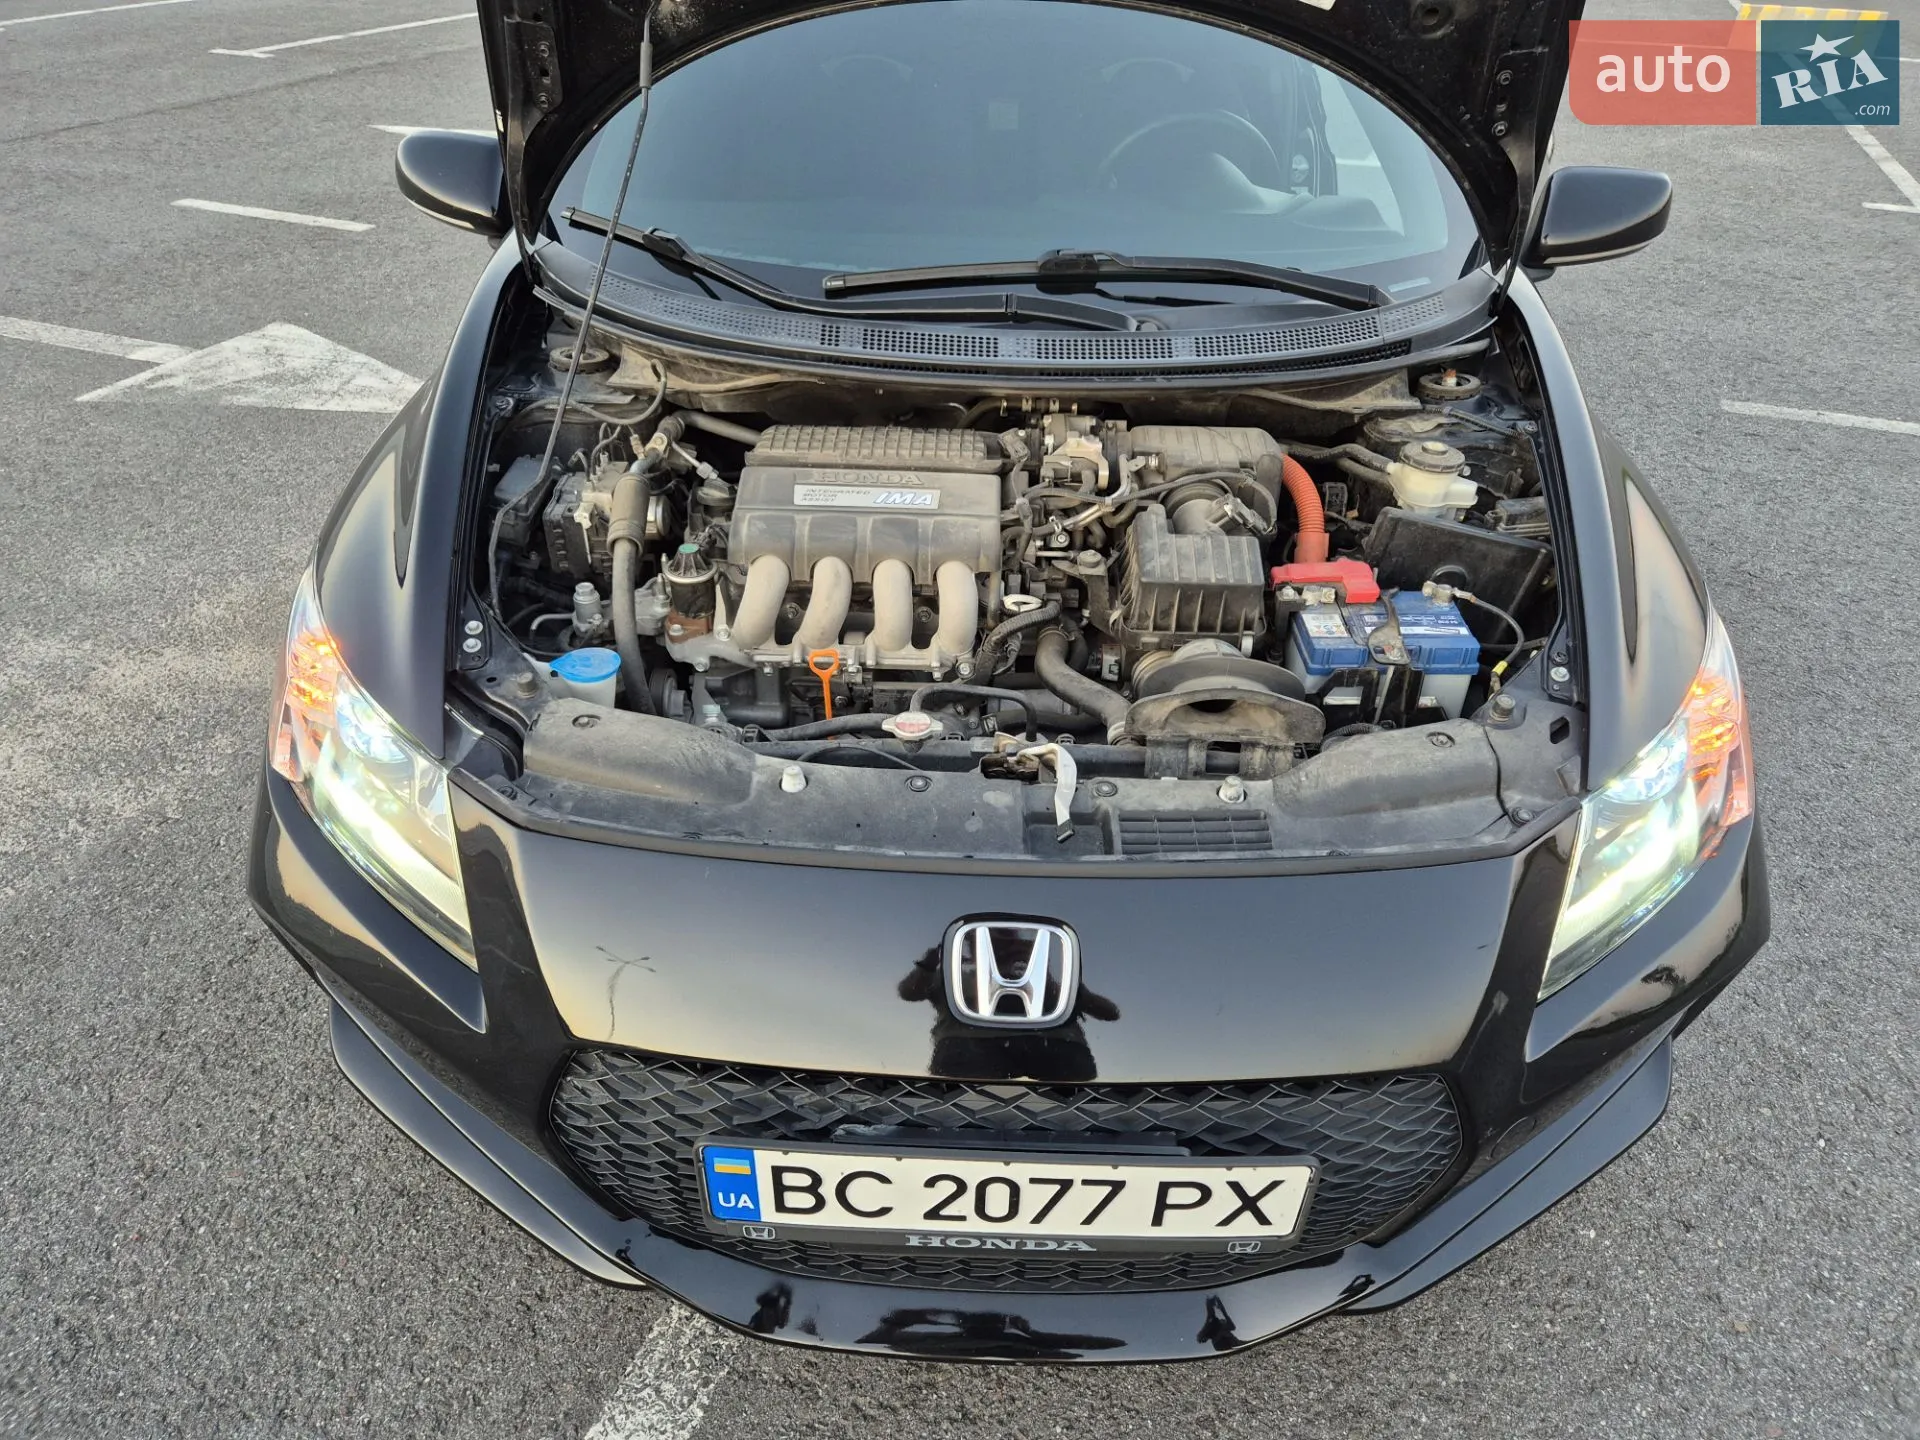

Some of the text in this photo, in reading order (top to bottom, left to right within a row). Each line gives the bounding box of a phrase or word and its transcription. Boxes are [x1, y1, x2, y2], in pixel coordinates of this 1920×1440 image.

[814, 471, 925, 486] HONDA
[873, 491, 934, 506] IMA
[718, 1192, 754, 1209] UA
[771, 1165, 1286, 1227] BC 2077 PX
[905, 1234, 1097, 1251] HONDA
